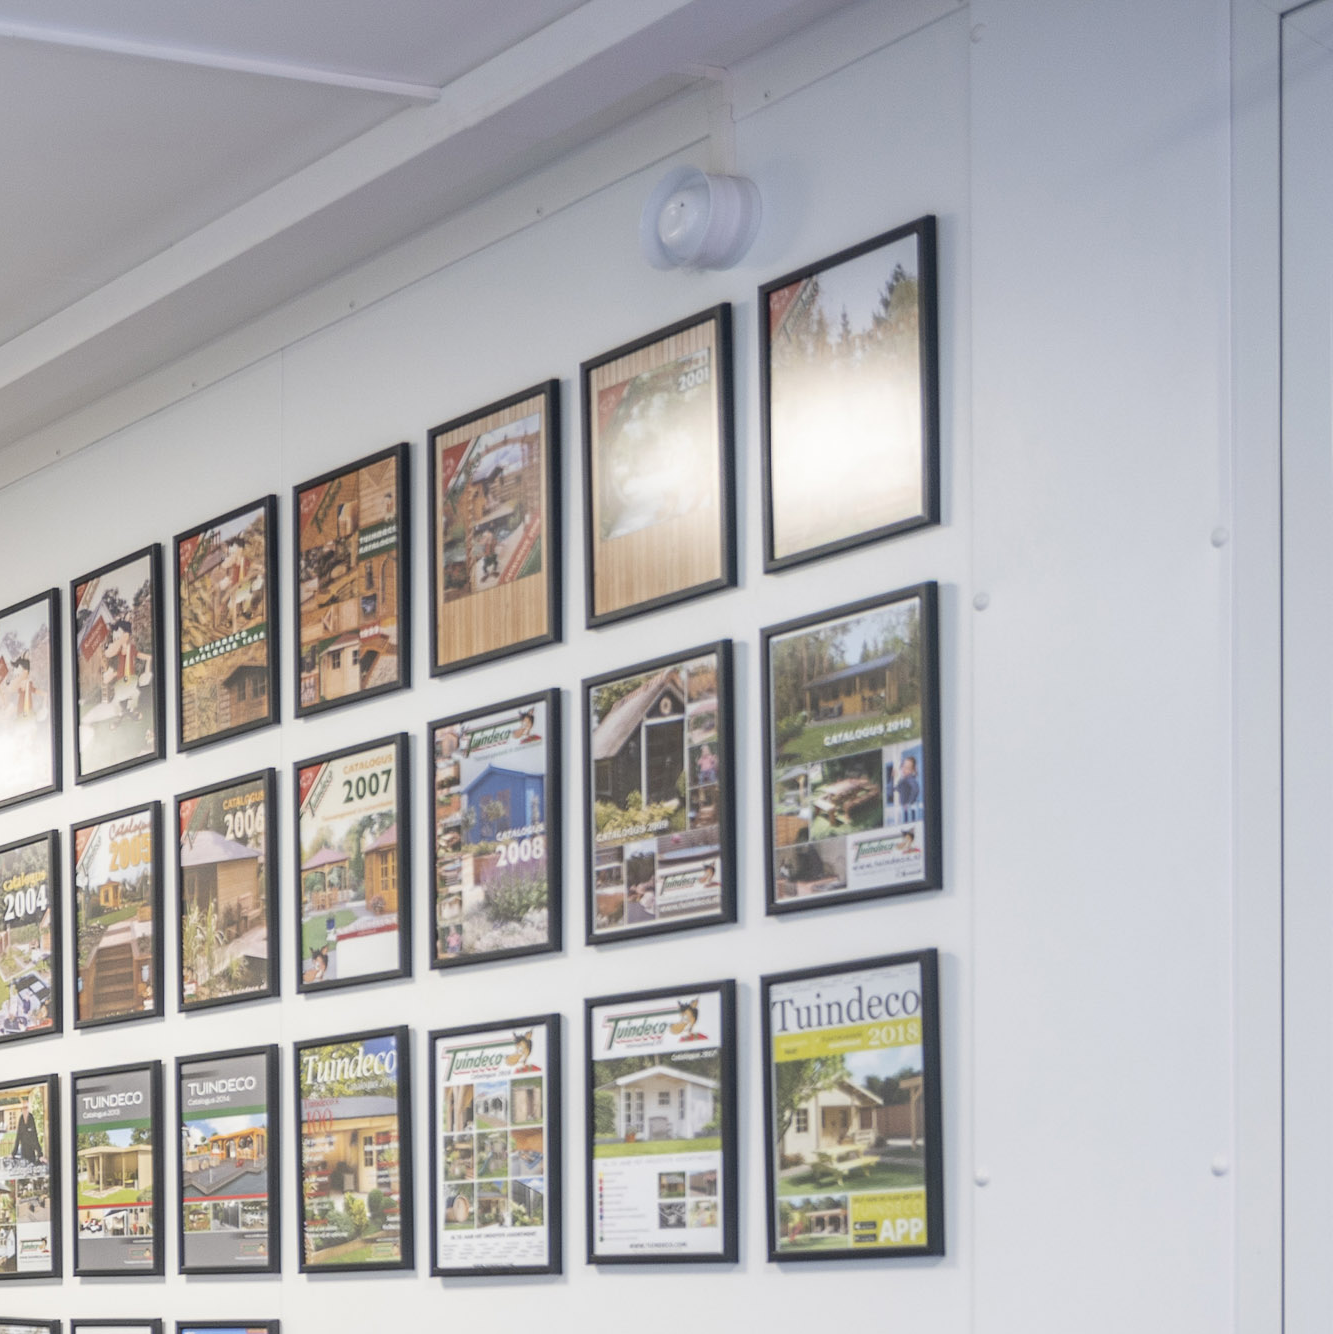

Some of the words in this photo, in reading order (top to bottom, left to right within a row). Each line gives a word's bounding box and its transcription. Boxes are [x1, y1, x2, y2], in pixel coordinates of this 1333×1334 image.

[678, 367, 710, 391] 2001
[199, 631, 247, 654] TUINDECO
[823, 723, 885, 747] CATALOGUS
[886, 717, 913, 733] 2010
[342, 753, 393, 775] CATALOGUS
[222, 789, 265, 811] CATALOGUS
[342, 768, 392, 804] 2007
[108, 832, 152, 872] 2005
[495, 836, 544, 867] 2008
[3, 884, 48, 921] 2004
[771, 985, 921, 1032] Tuindeco
[603, 1010, 674, 1050] Tuindeco
[868, 1022, 919, 1045] 2018
[302, 1046, 398, 1085] Tuindeco
[443, 1042, 511, 1081] Tuindeco
[83, 1091, 143, 1110] TUINDECO
[187, 1076, 257, 1097] TUINDECO
[878, 1217, 924, 1242] APP
